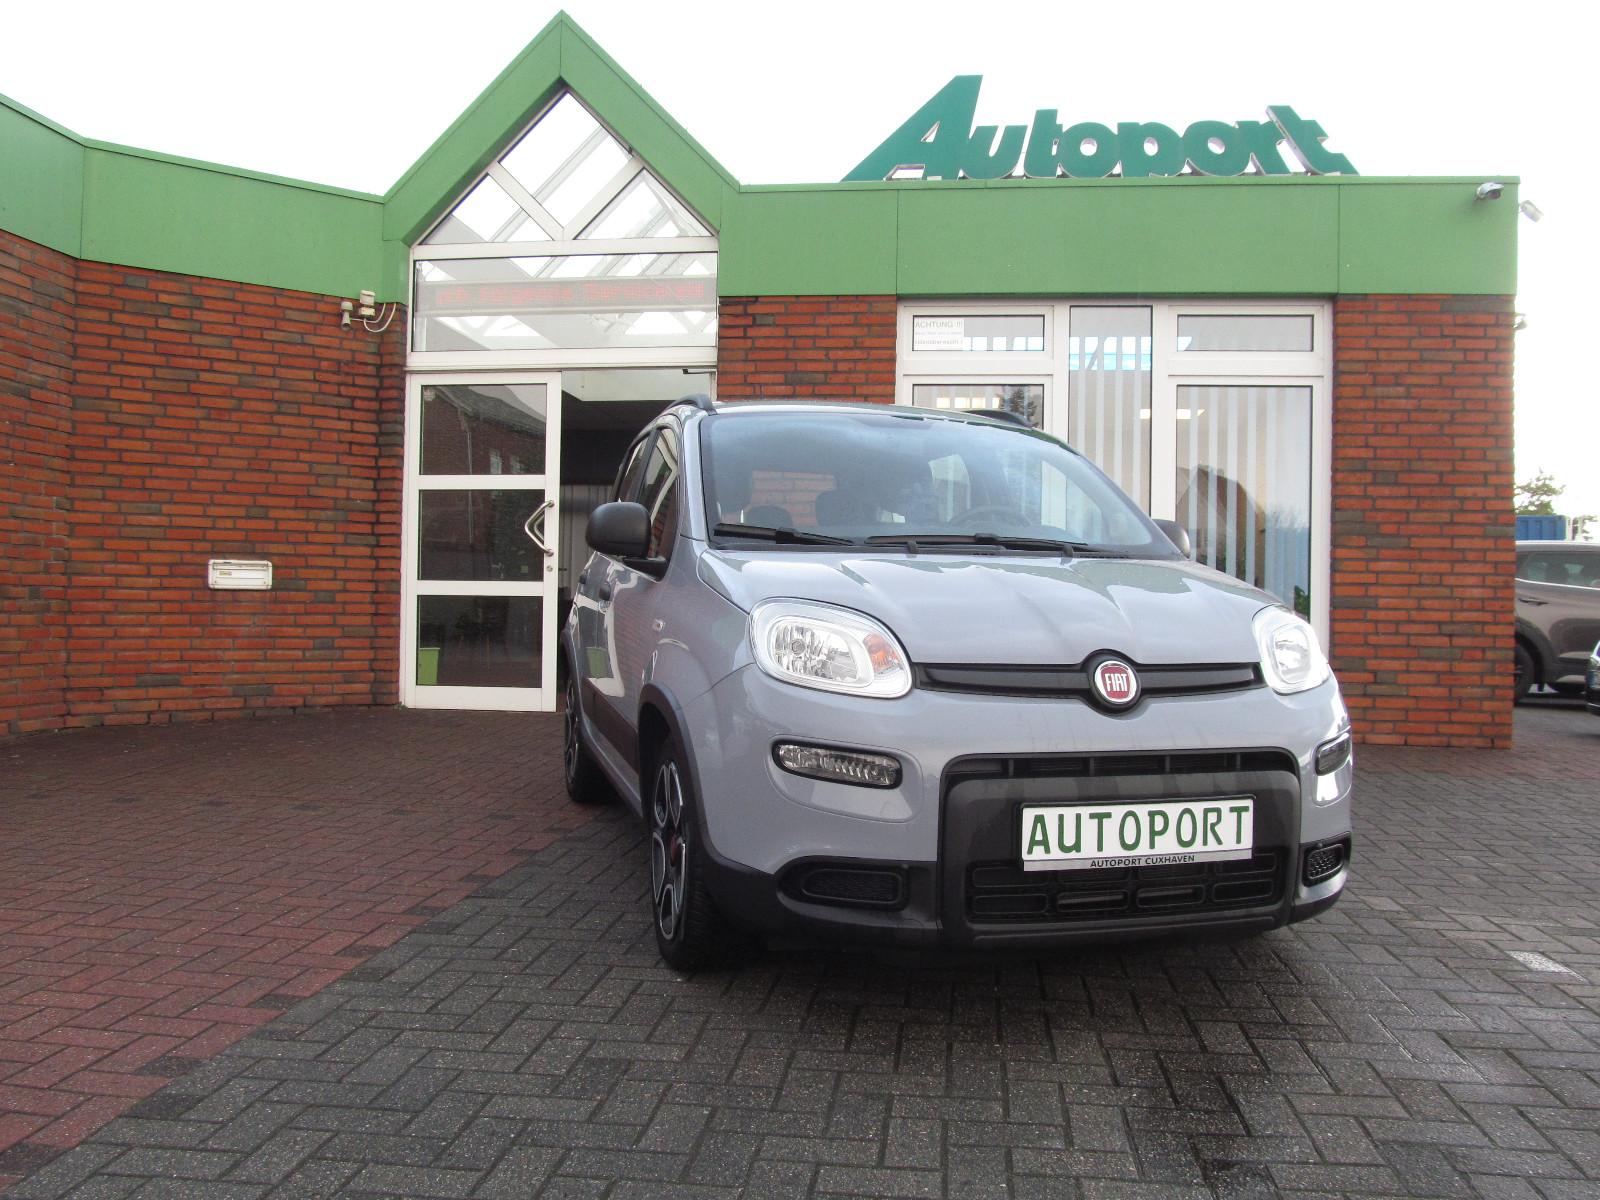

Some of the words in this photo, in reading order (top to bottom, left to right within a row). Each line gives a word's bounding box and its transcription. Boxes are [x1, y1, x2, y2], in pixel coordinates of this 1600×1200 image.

[839, 75, 1361, 181] Autoport
[914, 320, 954, 329] ACHTUNG
[1104, 673, 1128, 692] FIAT
[1026, 805, 1250, 855] AUTOPORT
[1089, 857, 1142, 868] AUTOPORT
[1145, 855, 1195, 865] CUXHAVEN
